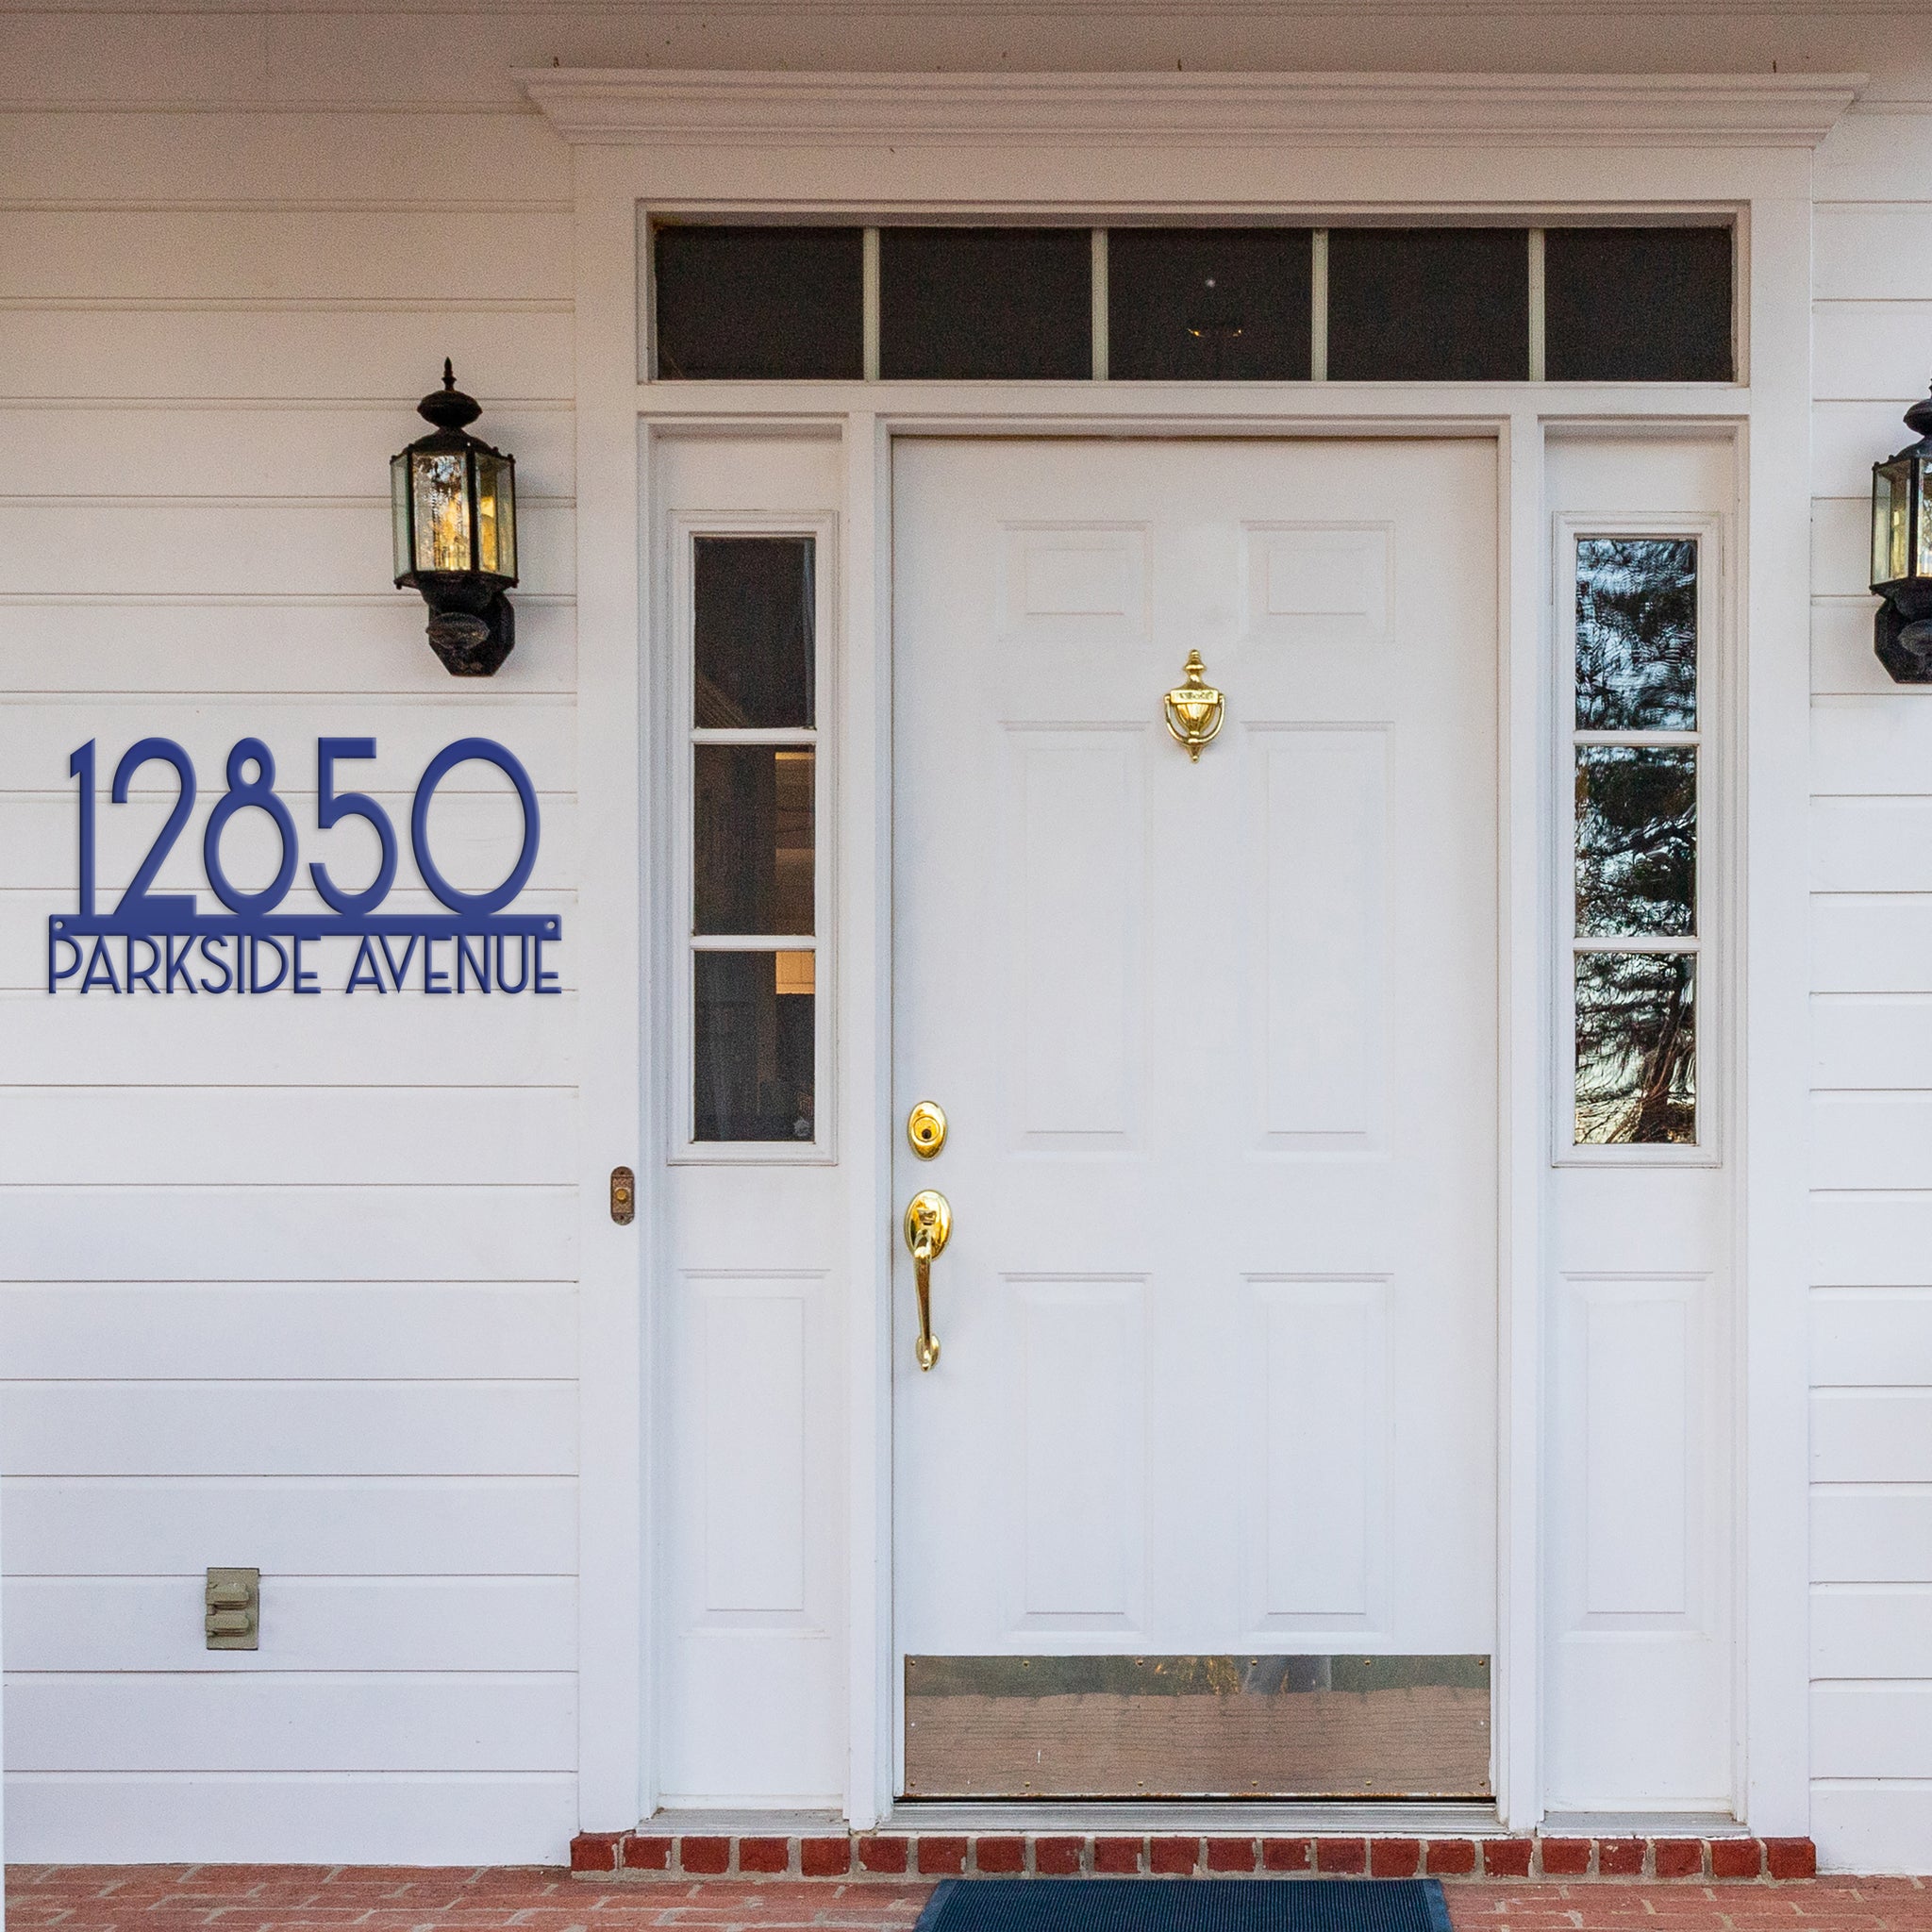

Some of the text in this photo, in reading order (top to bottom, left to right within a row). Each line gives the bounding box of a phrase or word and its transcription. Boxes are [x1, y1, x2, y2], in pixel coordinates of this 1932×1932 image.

[70, 737, 540, 915] 12850
[49, 933, 561, 994] PARKSIDE AVENUE
